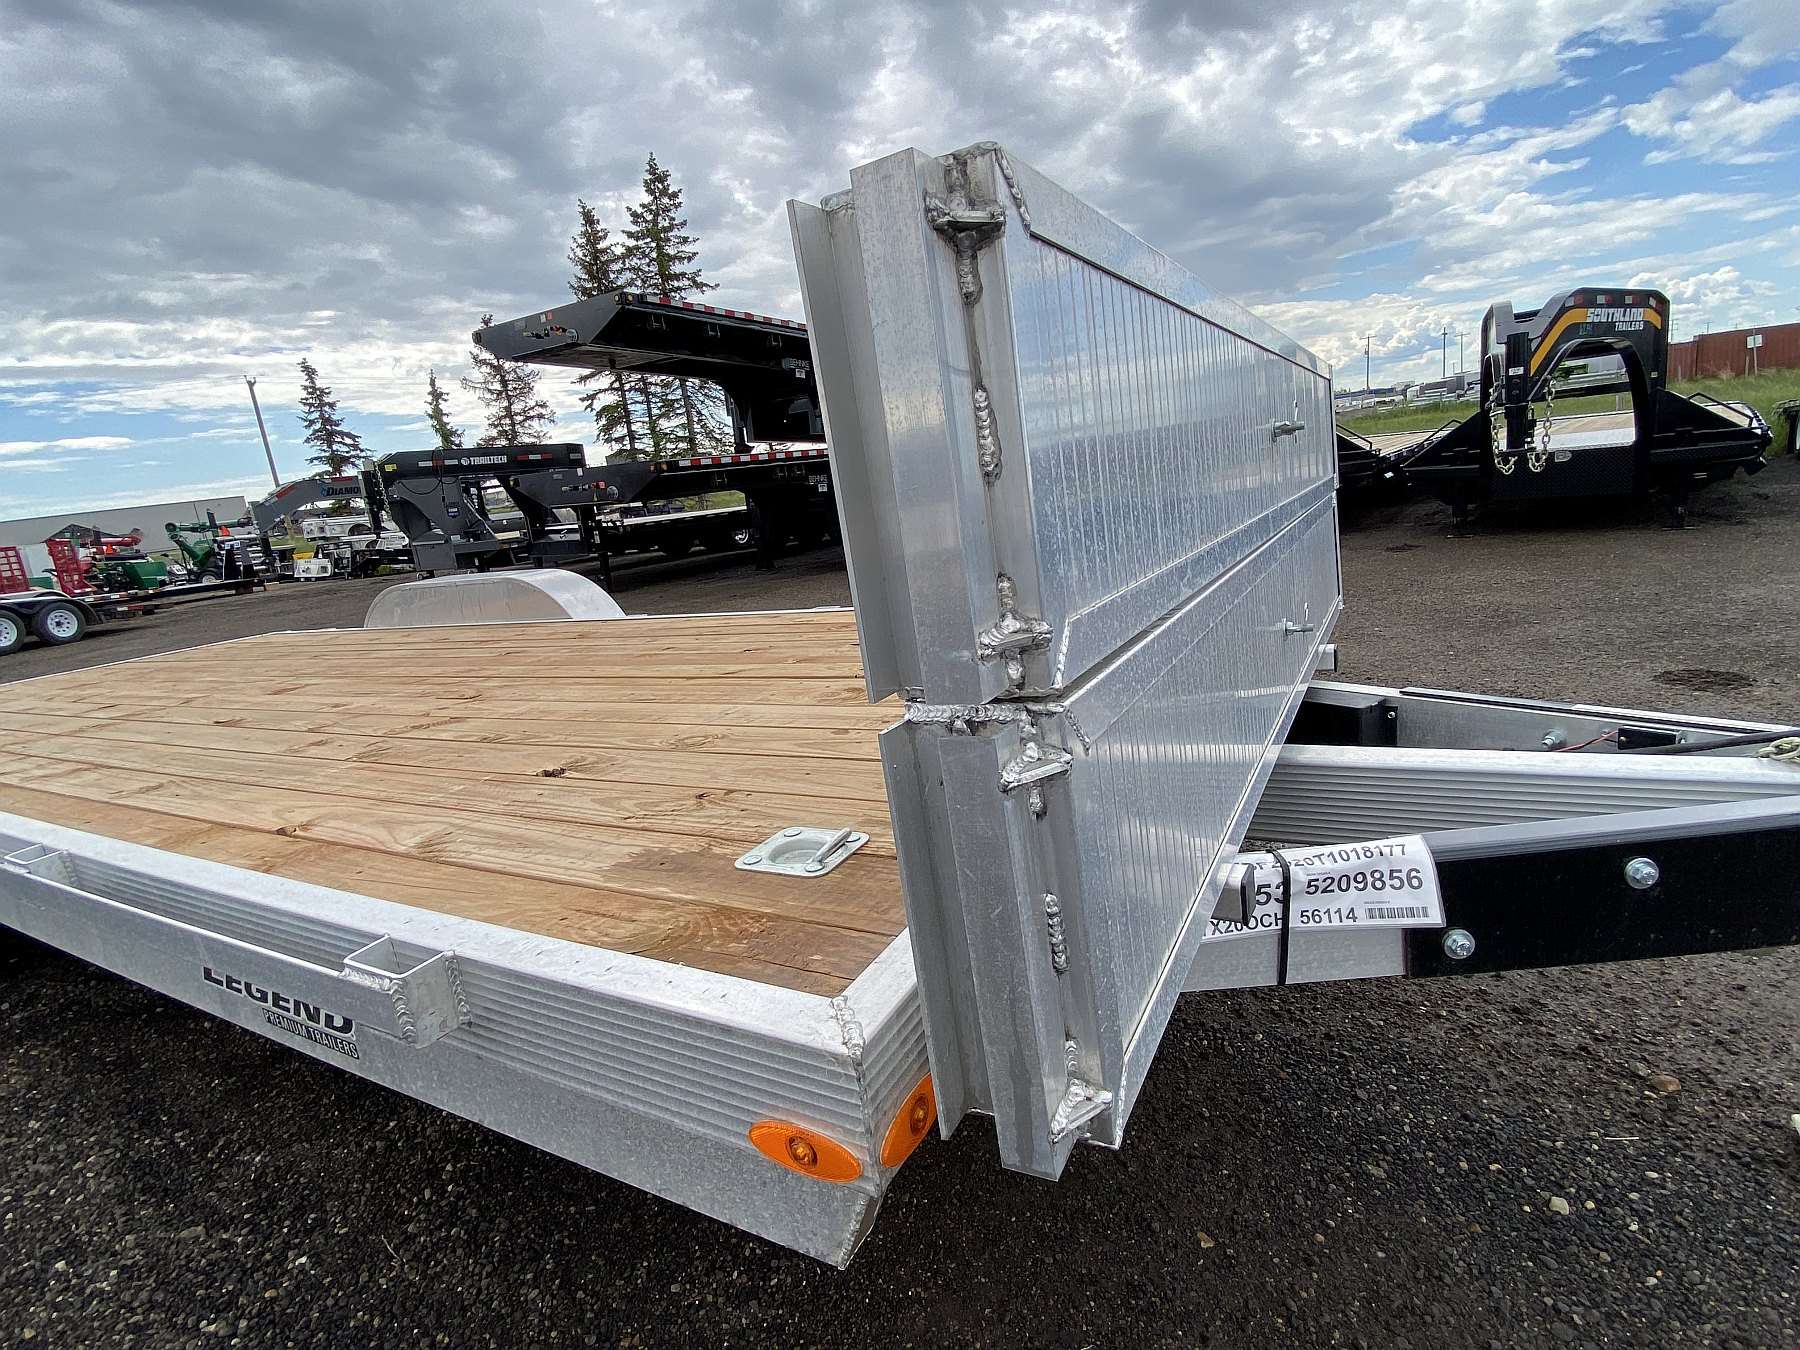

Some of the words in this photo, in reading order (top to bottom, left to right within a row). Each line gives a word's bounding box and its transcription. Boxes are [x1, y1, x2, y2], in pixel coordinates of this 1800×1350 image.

[1586, 307, 1644, 323] SOUTHLAND
[1615, 321, 1644, 331] TRAILERS
[469, 455, 507, 465] TRAILTECH
[1304, 867, 1424, 896] 5209856
[1299, 906, 1358, 925] 56114
[202, 966, 355, 1035] LEGEND
[263, 1009, 308, 1039] PREMIUM
[309, 1028, 359, 1059] TRAILERS
